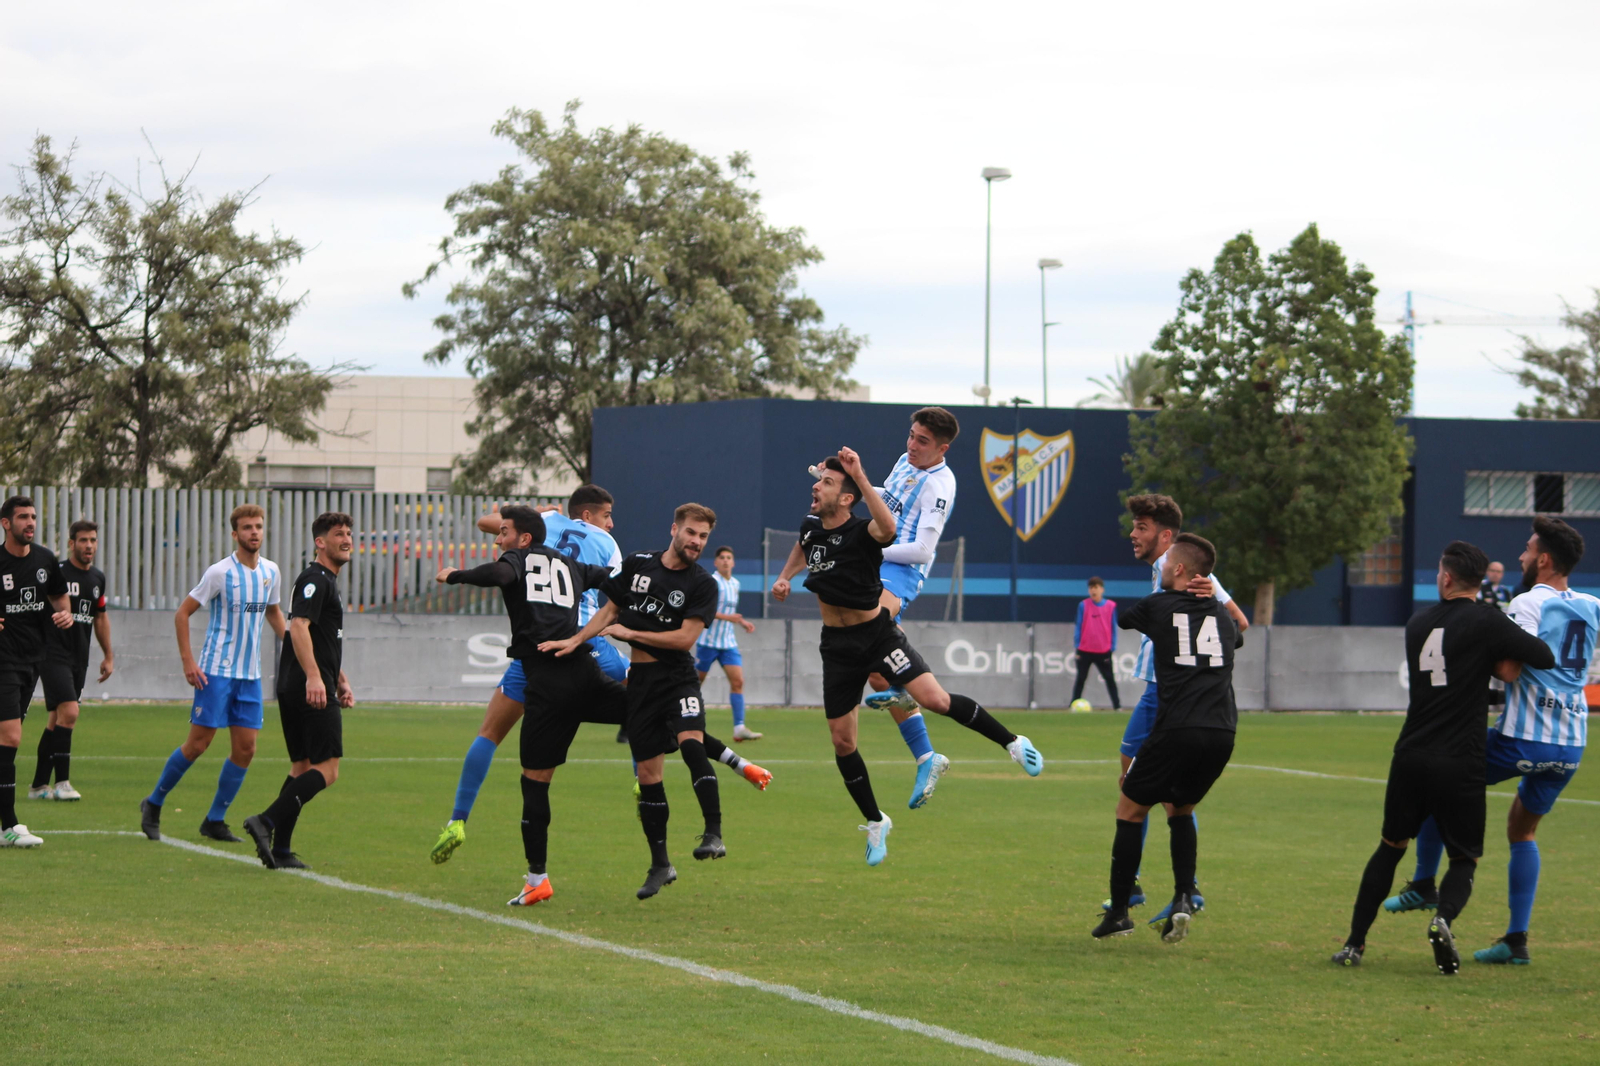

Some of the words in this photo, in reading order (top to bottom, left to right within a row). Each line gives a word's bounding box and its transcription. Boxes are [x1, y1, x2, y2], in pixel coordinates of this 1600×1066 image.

[554, 529, 588, 560] 5
[2, 573, 14, 591] 5
[66, 582, 80, 596] 10
[525, 553, 575, 609] 20
[630, 573, 652, 593] 19
[1173, 613, 1224, 667] 14
[1560, 619, 1587, 679] 4
[883, 648, 911, 673] 12
[1419, 628, 1448, 687] 4
[679, 696, 700, 715] 19
